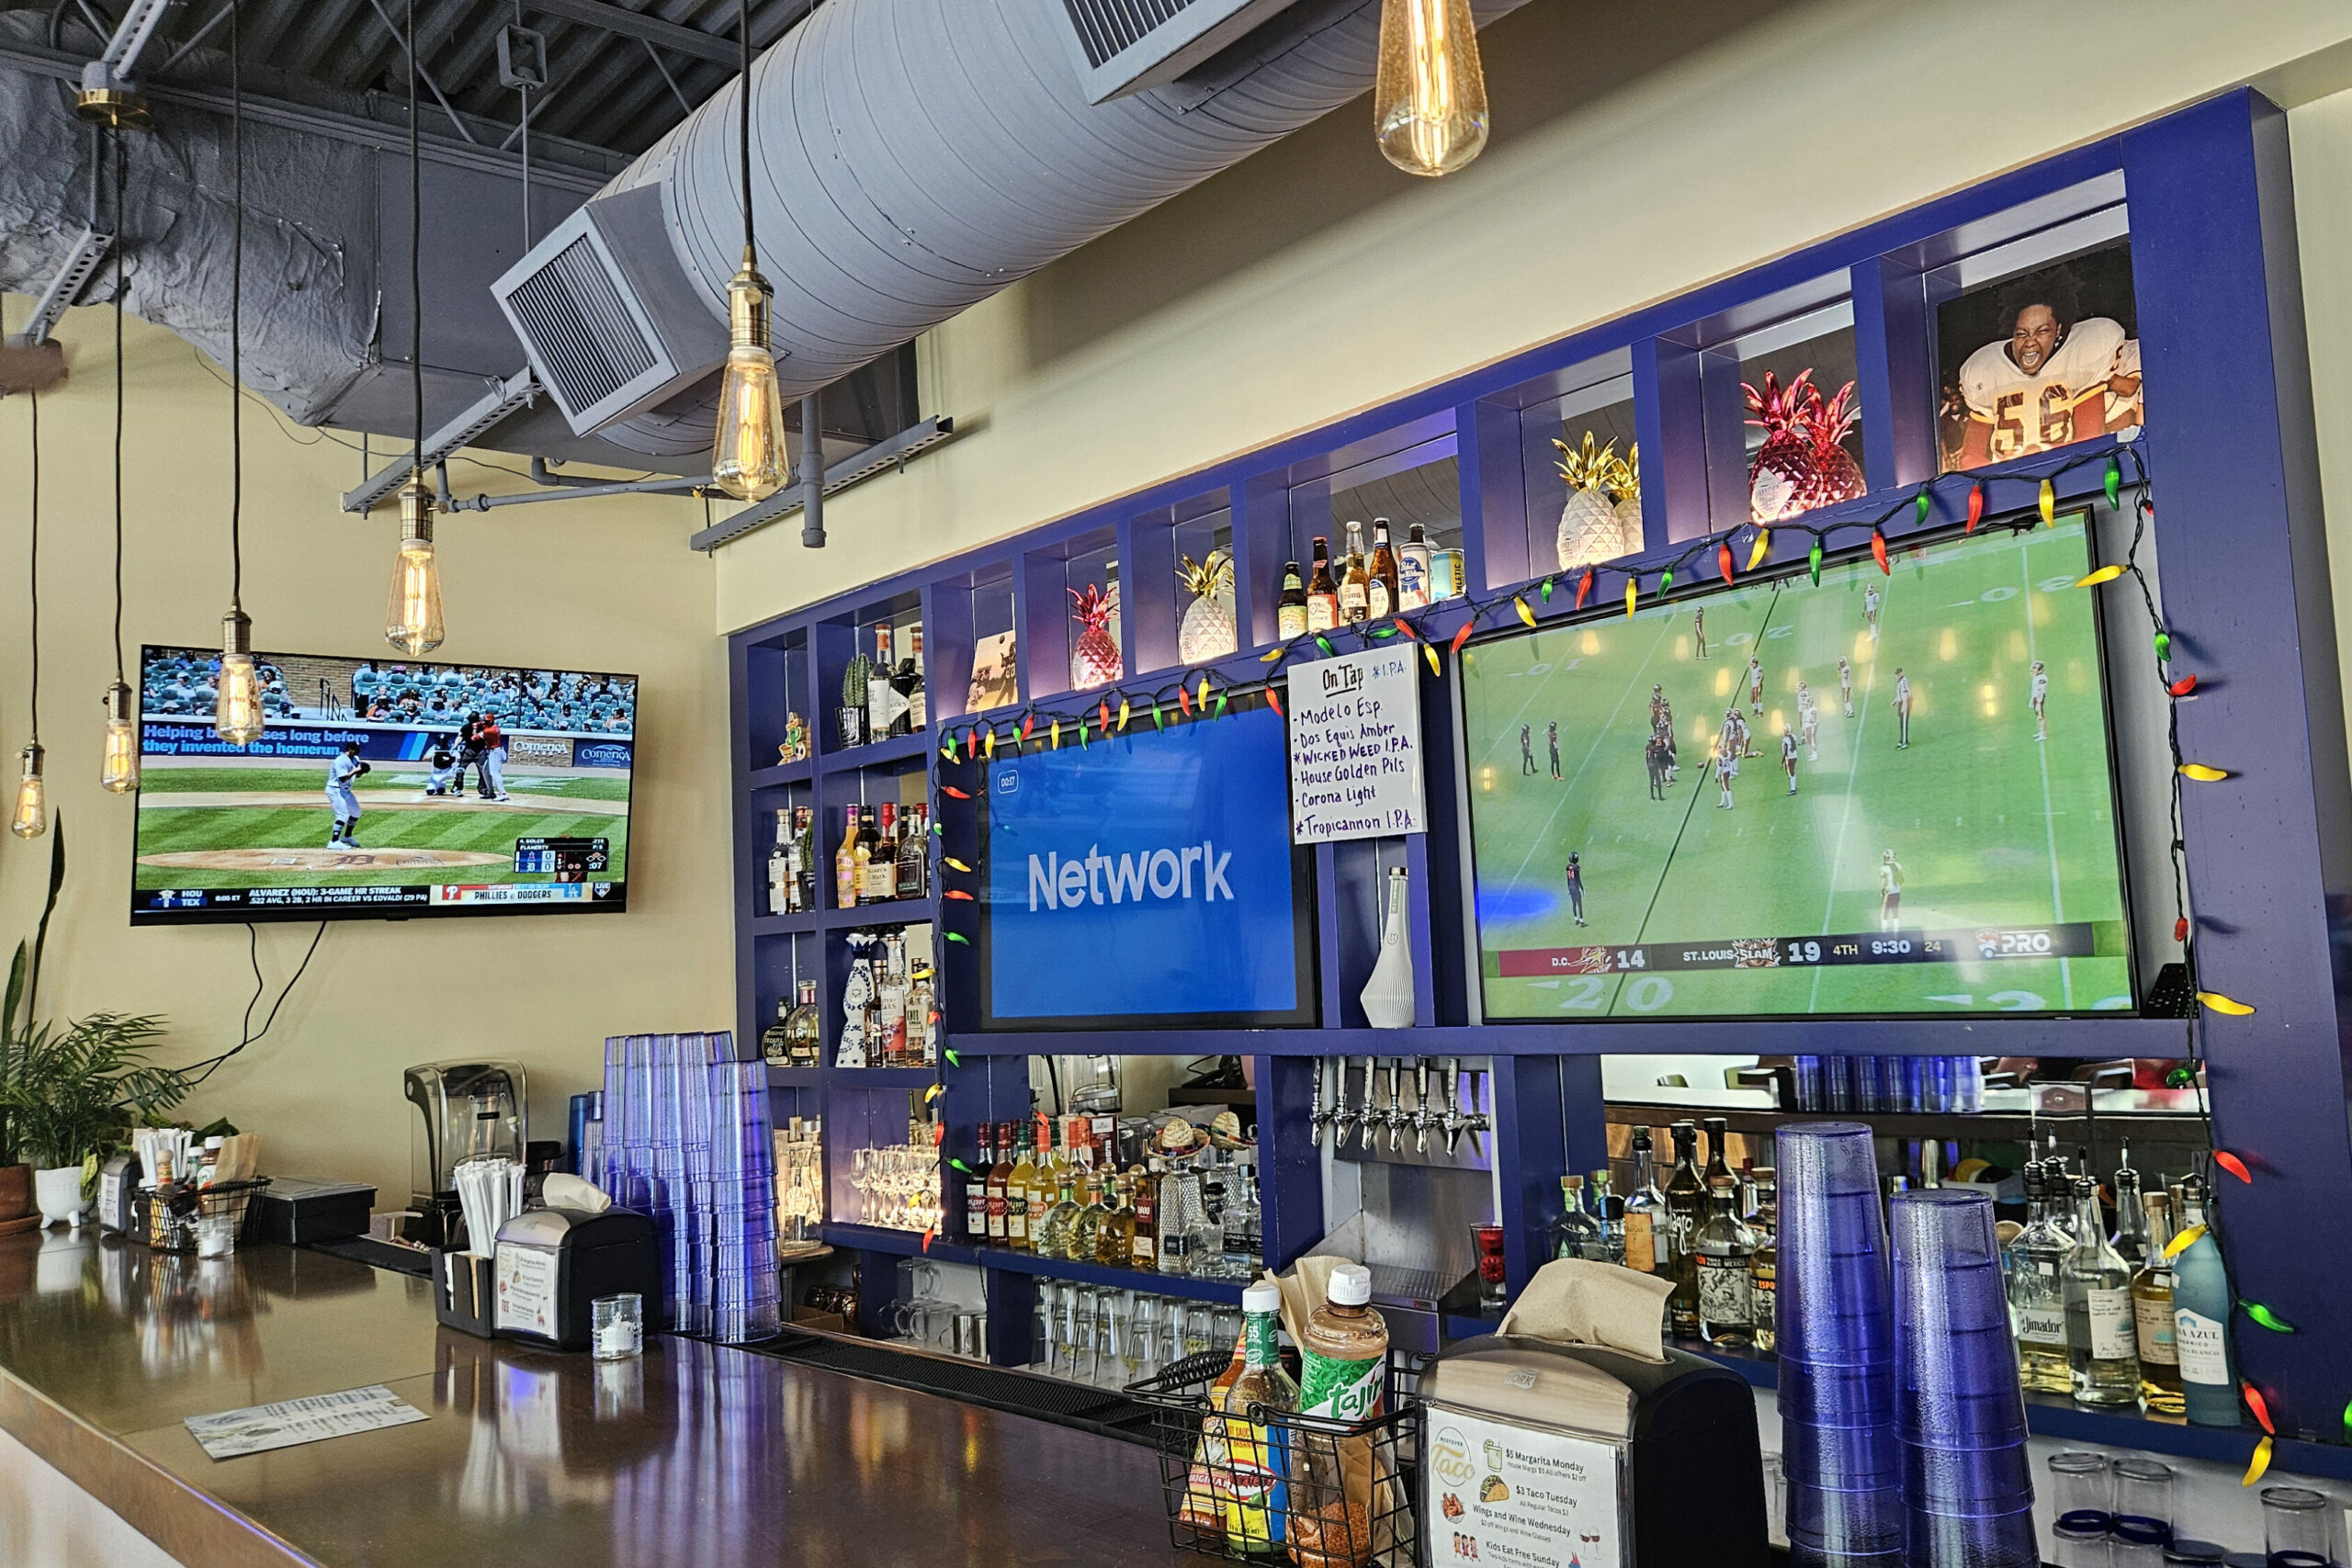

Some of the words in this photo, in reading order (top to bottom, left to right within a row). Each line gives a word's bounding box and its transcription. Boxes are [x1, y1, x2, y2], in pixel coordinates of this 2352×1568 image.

[1996, 384, 2070, 455] 56
[1322, 668, 1338, 690] On
[1338, 663, 1363, 691] Tap
[1301, 703, 1351, 726] Modelo
[143, 724, 204, 739] Helping
[289, 729, 322, 743] long
[323, 729, 369, 743] before
[1300, 732, 1320, 749] Dos
[1325, 725, 1355, 747] Equis
[1360, 722, 1396, 738] Amber
[142, 739, 178, 755] they
[180, 739, 245, 754] invented
[248, 741, 274, 754] the
[1302, 749, 1347, 765] WICKED
[1349, 743, 1381, 760] WEED
[1300, 769, 1332, 787] House
[1334, 762, 1377, 781] Golden
[1381, 757, 1406, 775] Pils
[1302, 791, 1342, 808] Corona
[1346, 784, 1376, 807] Light
[1028, 840, 1234, 912] Network
[249, 888, 289, 897] ALVAREZ
[320, 887, 354, 896] 3-GAME
[368, 886, 401, 895] STREAK
[474, 890, 508, 900] PHILLIES
[517, 890, 552, 899] DODGERS
[181, 898, 200, 907] TEX
[1788, 941, 1821, 962] 19
[1833, 943, 1859, 956] 4TH
[1871, 940, 1911, 954] 9:30
[1925, 941, 1941, 953] 24
[2000, 932, 2052, 953] PRO
[1551, 957, 1570, 966] D.C.
[1617, 950, 1645, 969] 14
[1683, 951, 1702, 961] ST.
[1702, 949, 1735, 961] LOUIS
[1738, 947, 1773, 961] SLAM
[1137, 1205, 1150, 1215] 1800
[1758, 1280, 1775, 1291] ESPO
[1440, 1437, 1464, 1447] WESTOVER
[1430, 1443, 1476, 1481] Taco
[1505, 1449, 1514, 1459] $5
[1515, 1451, 1551, 1466] Margarita
[1553, 1458, 1585, 1474] Monday
[1516, 1484, 1525, 1495] $3
[1526, 1487, 1544, 1499] Taco
[1545, 1491, 1578, 1508] Tuesday
[1472, 1504, 1492, 1517] Wings
[1493, 1511, 1507, 1520] and
[1507, 1513, 1527, 1525] Wine
[1527, 1517, 1571, 1538] Wednesday
[1532, 1531, 1552, 1542] Glasses
[1486, 1540, 1501, 1551] Kids
[1502, 1544, 1514, 1555] Eat
[1515, 1548, 1531, 1560] Free
[1532, 1552, 1560, 1568] Sunday
